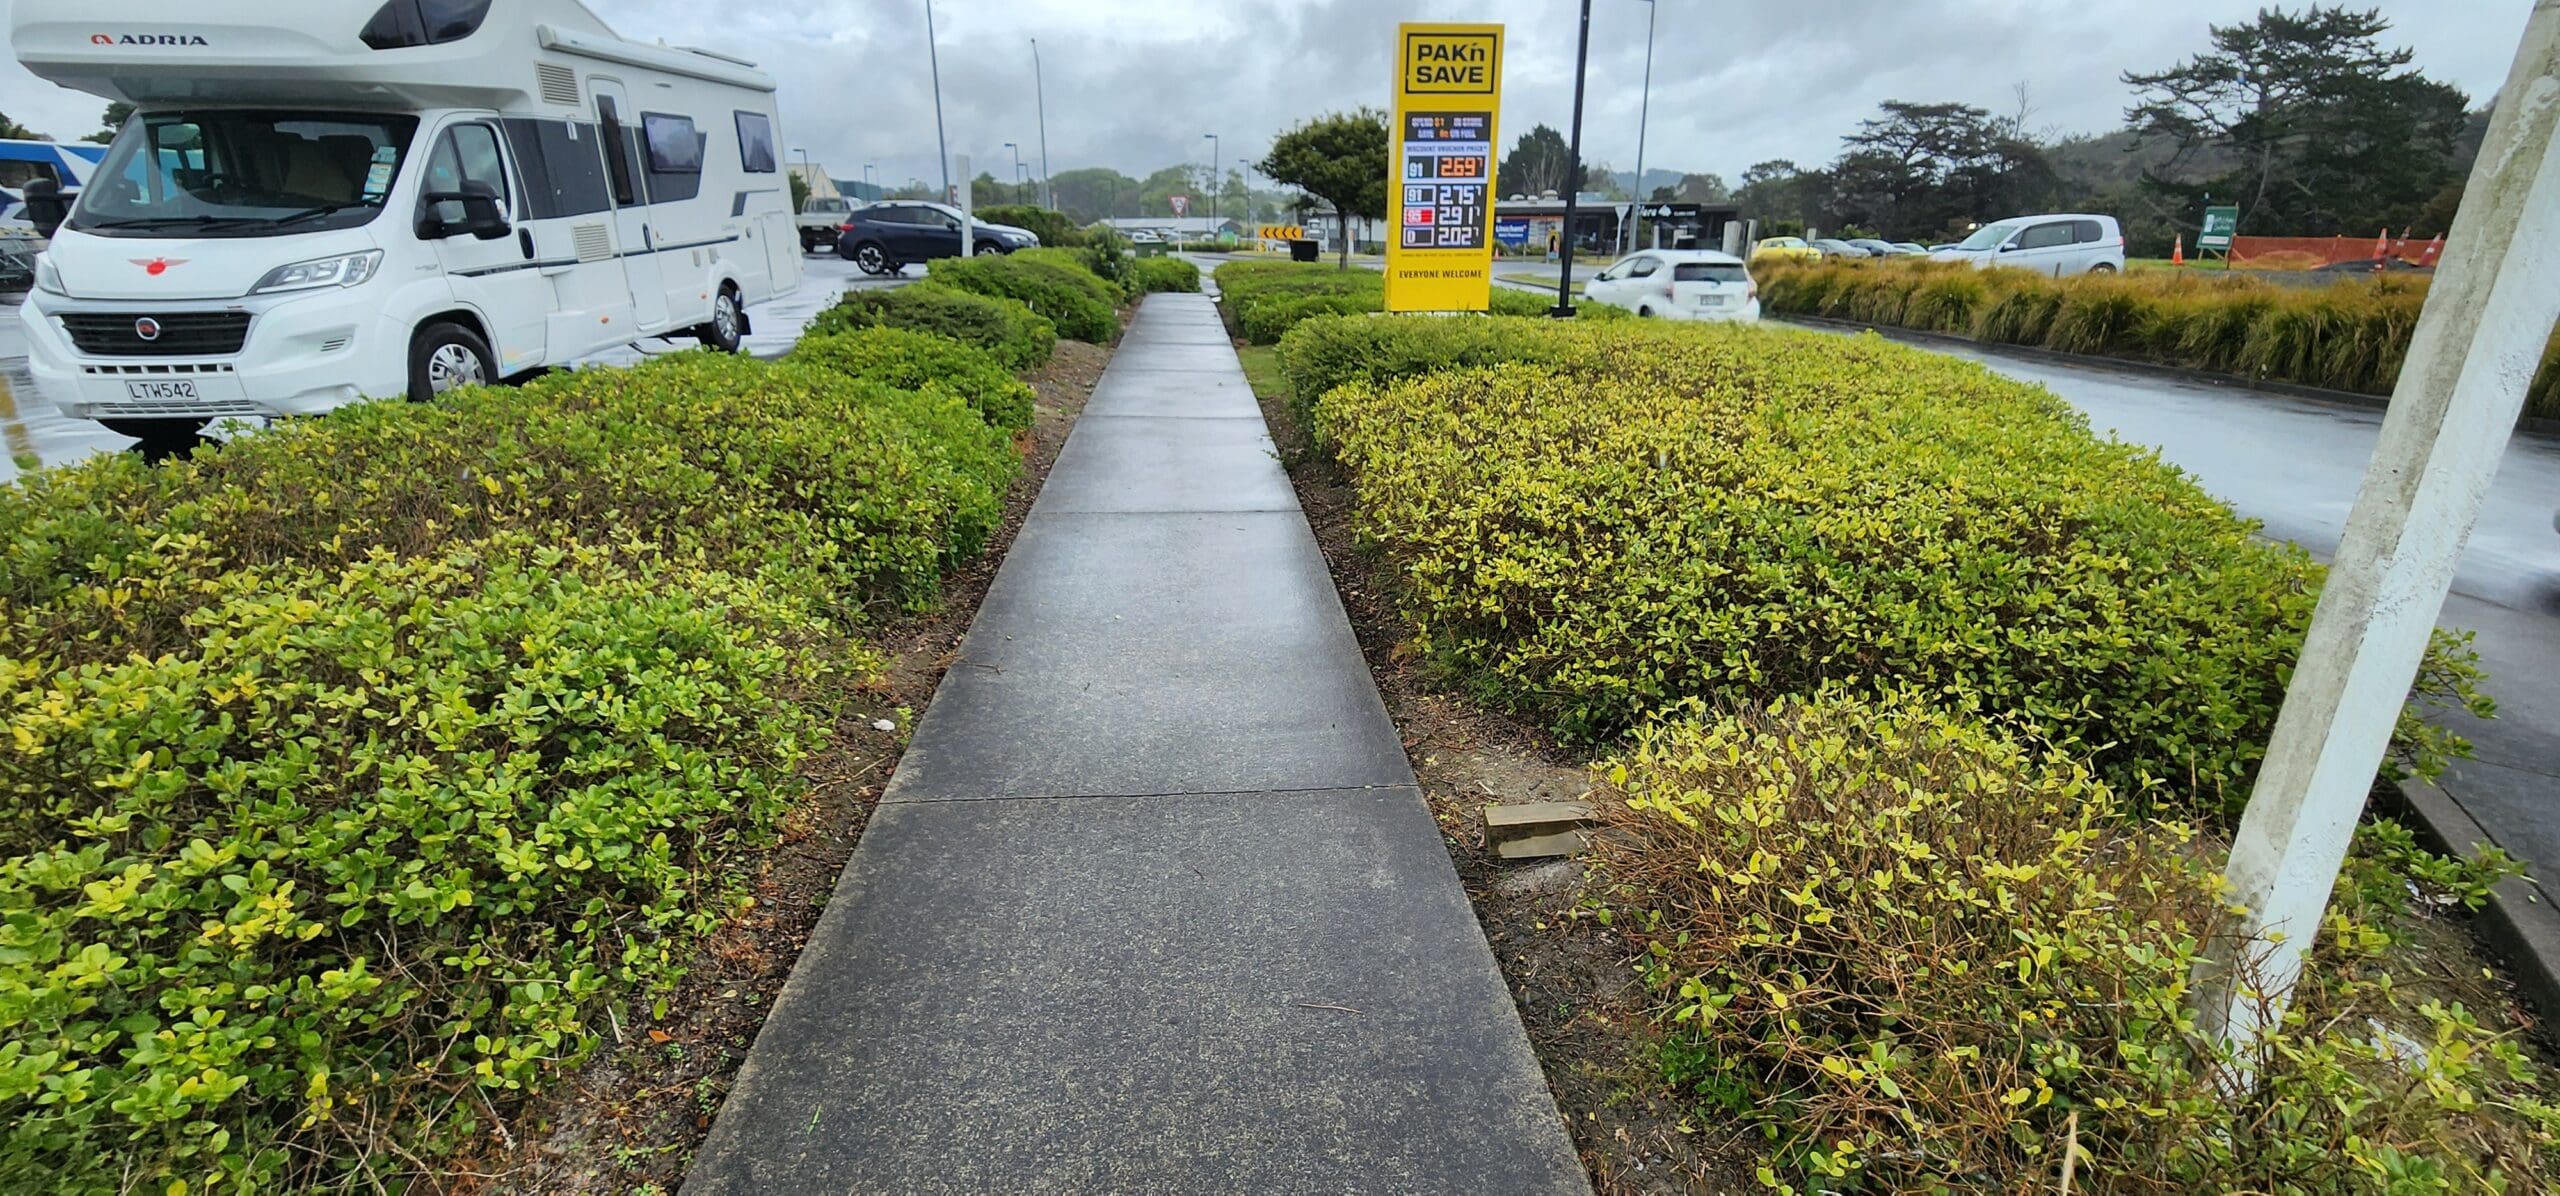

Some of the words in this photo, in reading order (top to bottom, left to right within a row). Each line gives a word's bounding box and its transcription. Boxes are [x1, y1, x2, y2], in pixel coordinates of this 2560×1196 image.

[119, 34, 209, 46] ADRIA
[1416, 66, 1484, 83] SAVE
[1408, 162, 1424, 178] 91
[1407, 188, 1423, 202] 91
[1399, 270, 1439, 279] EVERYONE
[1442, 270, 1482, 279] WELCOME
[128, 382, 195, 399] LTW542
